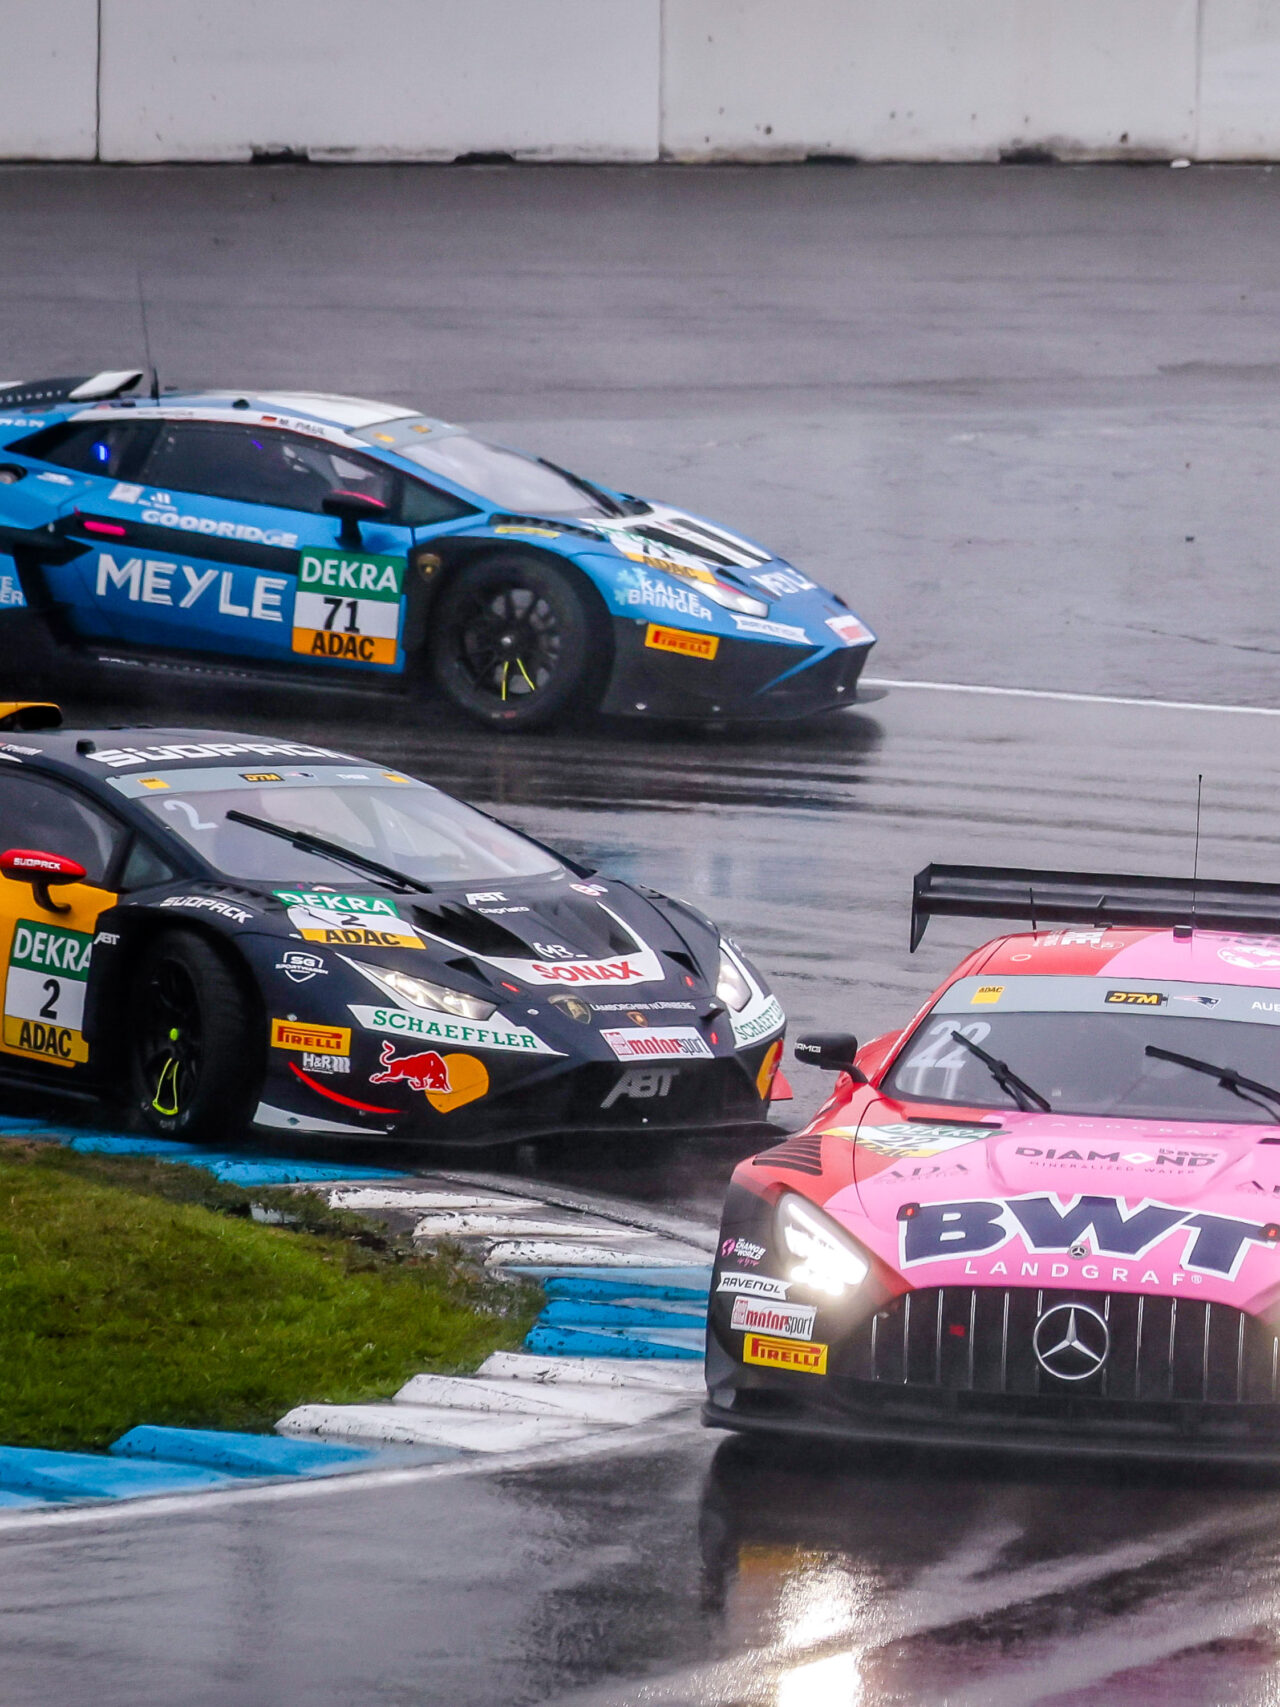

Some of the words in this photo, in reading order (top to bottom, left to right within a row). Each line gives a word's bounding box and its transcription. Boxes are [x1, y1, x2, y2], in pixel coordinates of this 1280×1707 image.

[141, 509, 299, 548] GOODRIDGE
[96, 553, 289, 623] MEYLE
[302, 556, 399, 594] DEKRA
[640, 575, 700, 602] KÄLTE
[322, 597, 361, 635] 71
[627, 588, 713, 622] BRINGER
[310, 632, 375, 661] ADAC
[652, 630, 712, 656] PIRELLI
[86, 743, 361, 769] SÜDPACK
[243, 773, 283, 783] DTM
[163, 799, 219, 832] 2
[159, 896, 255, 925] SÜDPACK
[274, 892, 397, 918] DEKRA
[465, 892, 509, 906] ABT
[336, 912, 368, 928] 2
[13, 927, 93, 973] DEKRA
[93, 931, 121, 946] ABT
[324, 929, 402, 946] ADAC
[289, 956, 317, 968] SG
[531, 961, 645, 983] SONAX
[39, 978, 61, 1020] 2
[978, 986, 1004, 994] ADAC
[1108, 991, 1160, 1005] DTM
[590, 1002, 650, 1012] LAMBORGHINI
[19, 1021, 72, 1059] ADAC
[277, 1025, 343, 1051] PIRELLI
[372, 1010, 538, 1050] SCHAEFFLER
[628, 1035, 711, 1057] motorsport
[905, 1020, 992, 1069] 22
[302, 1052, 333, 1071] H&R
[600, 1066, 681, 1110] ABT
[884, 1124, 994, 1139] DEKRA
[898, 1190, 1280, 1281] BWT
[722, 1276, 782, 1295] RAVENOL
[745, 1309, 813, 1337] motorsport
[751, 1337, 822, 1367] PIRELLI
